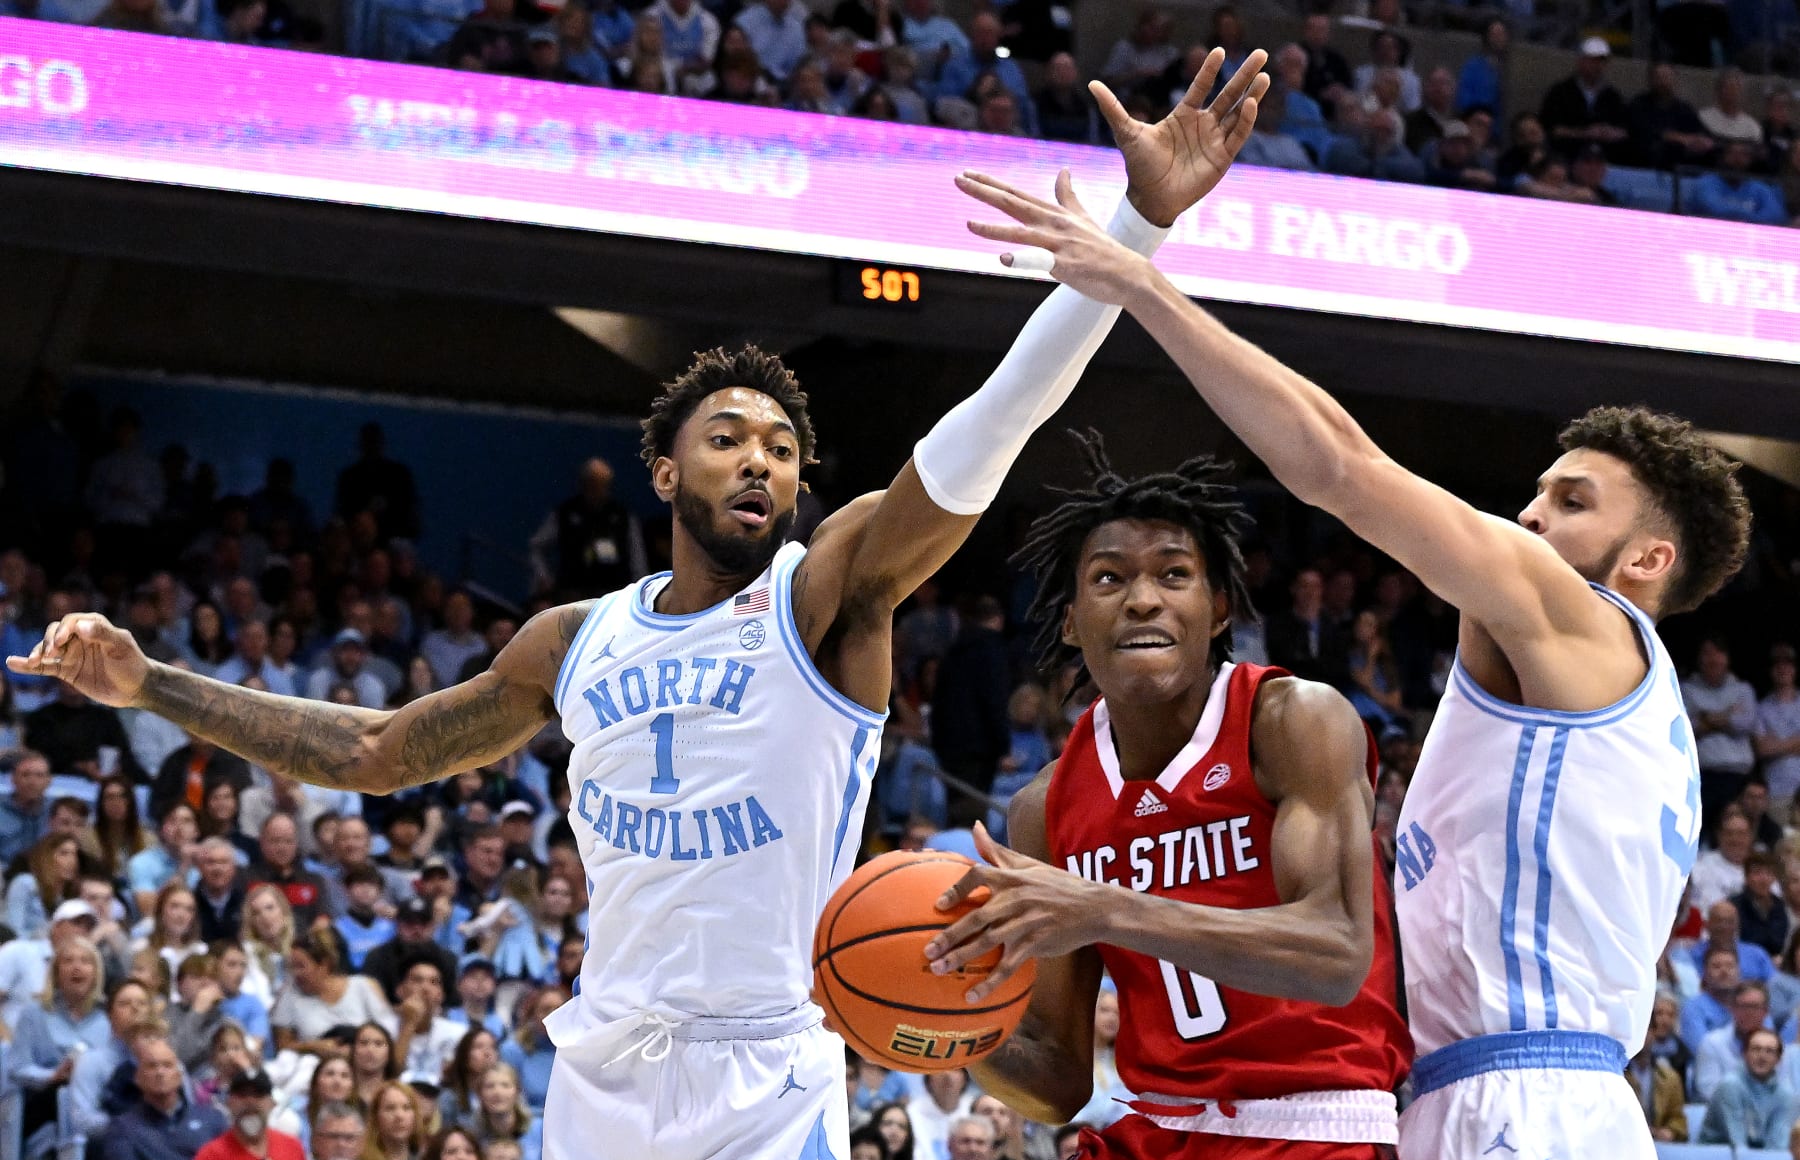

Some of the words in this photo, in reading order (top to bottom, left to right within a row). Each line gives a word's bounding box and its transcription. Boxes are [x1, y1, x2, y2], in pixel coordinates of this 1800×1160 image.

[1269, 204, 1473, 275] FARGO
[582, 657, 756, 730] NORTH
[650, 713, 680, 795] 1
[577, 778, 784, 862] CAROLINA
[1134, 803, 1169, 817] adidas
[1129, 814, 1259, 893] STATE
[891, 1027, 1004, 1059] ELITE
